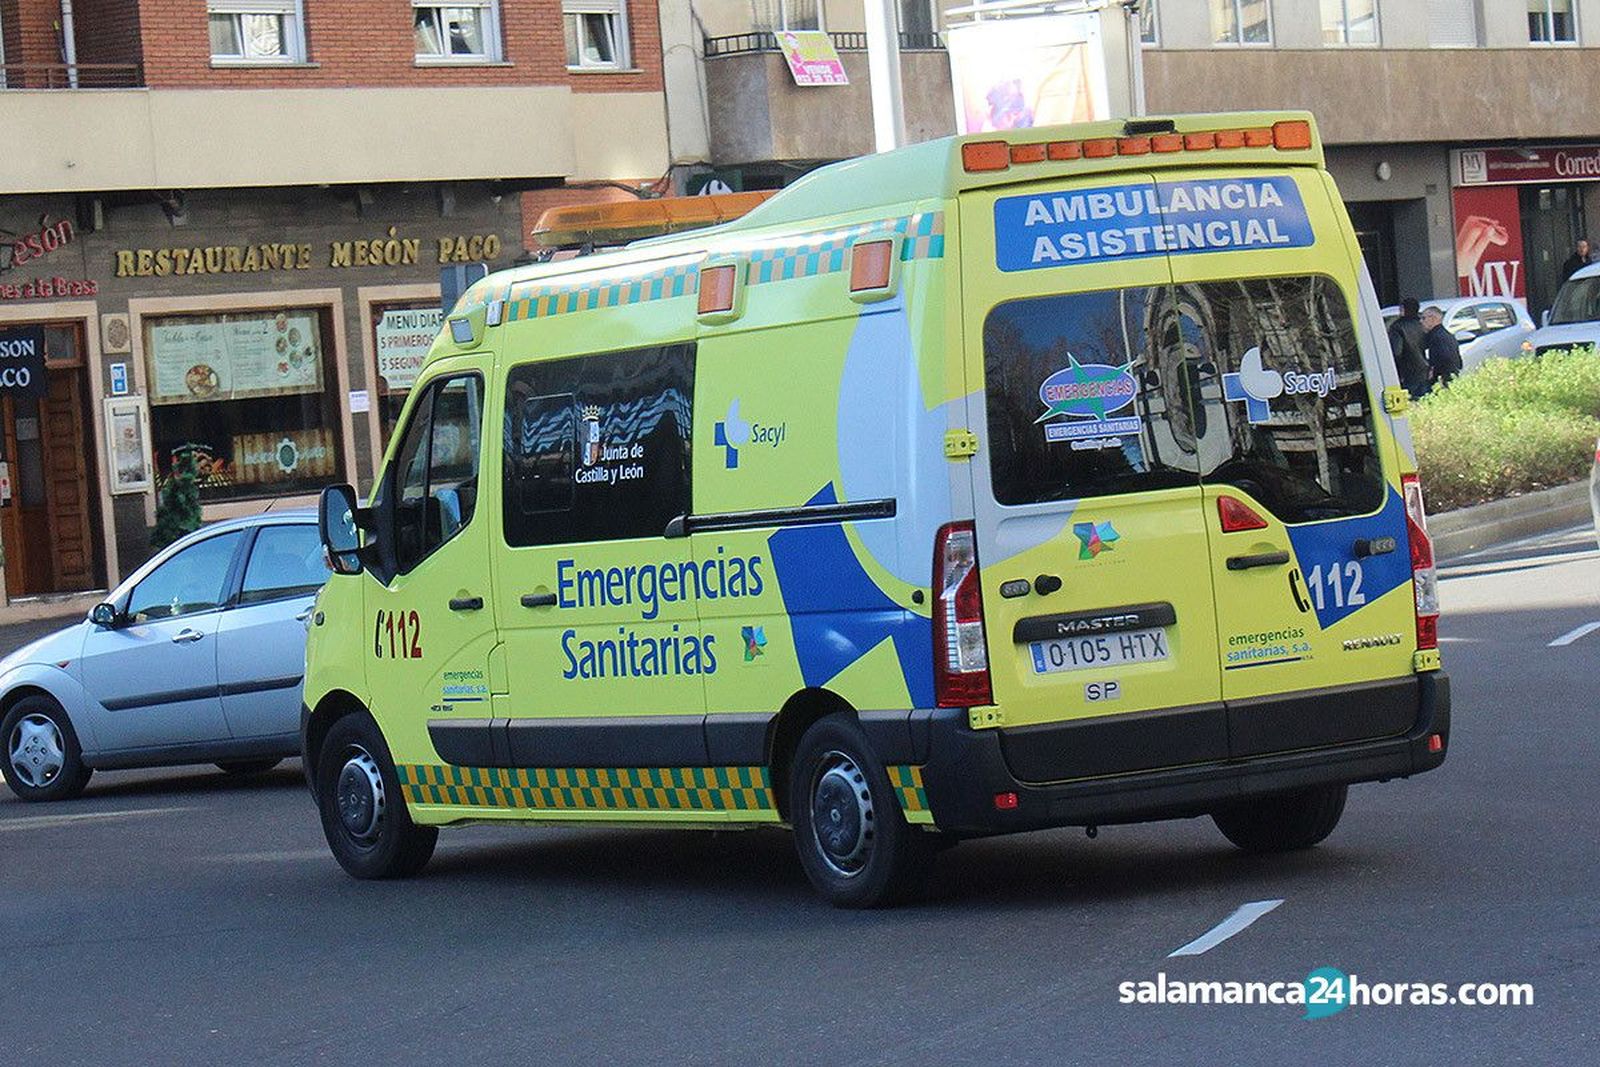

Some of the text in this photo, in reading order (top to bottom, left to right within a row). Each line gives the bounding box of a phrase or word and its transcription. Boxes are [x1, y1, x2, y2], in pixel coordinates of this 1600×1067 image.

[1024, 182, 1284, 226] AMBULANCIA
[116, 226, 501, 278] RESTAURANTE MESÓN PACO
[1031, 218, 1290, 263] ASISTENCIAL
[1468, 261, 1520, 298] MV
[0, 367, 31, 387] CO
[1045, 379, 1133, 402] EMERGENCIAS
[1284, 367, 1336, 397] Sacyl
[752, 422, 785, 448] Sacyl
[1048, 420, 1138, 438] EMERGENCIAS SANITARIAS
[601, 443, 644, 461] Junta de
[575, 462, 644, 485] Castilla y León
[556, 546, 764, 620] Emergencias
[1308, 560, 1366, 610] 112
[385, 610, 422, 659] 112
[1057, 614, 1140, 634] MASTER
[1228, 626, 1304, 646] emergencias
[561, 624, 717, 680] Sanitarias
[1050, 632, 1165, 667] 0105 HTX
[1343, 633, 1402, 651] RENAULT
[1086, 682, 1117, 700] SP
